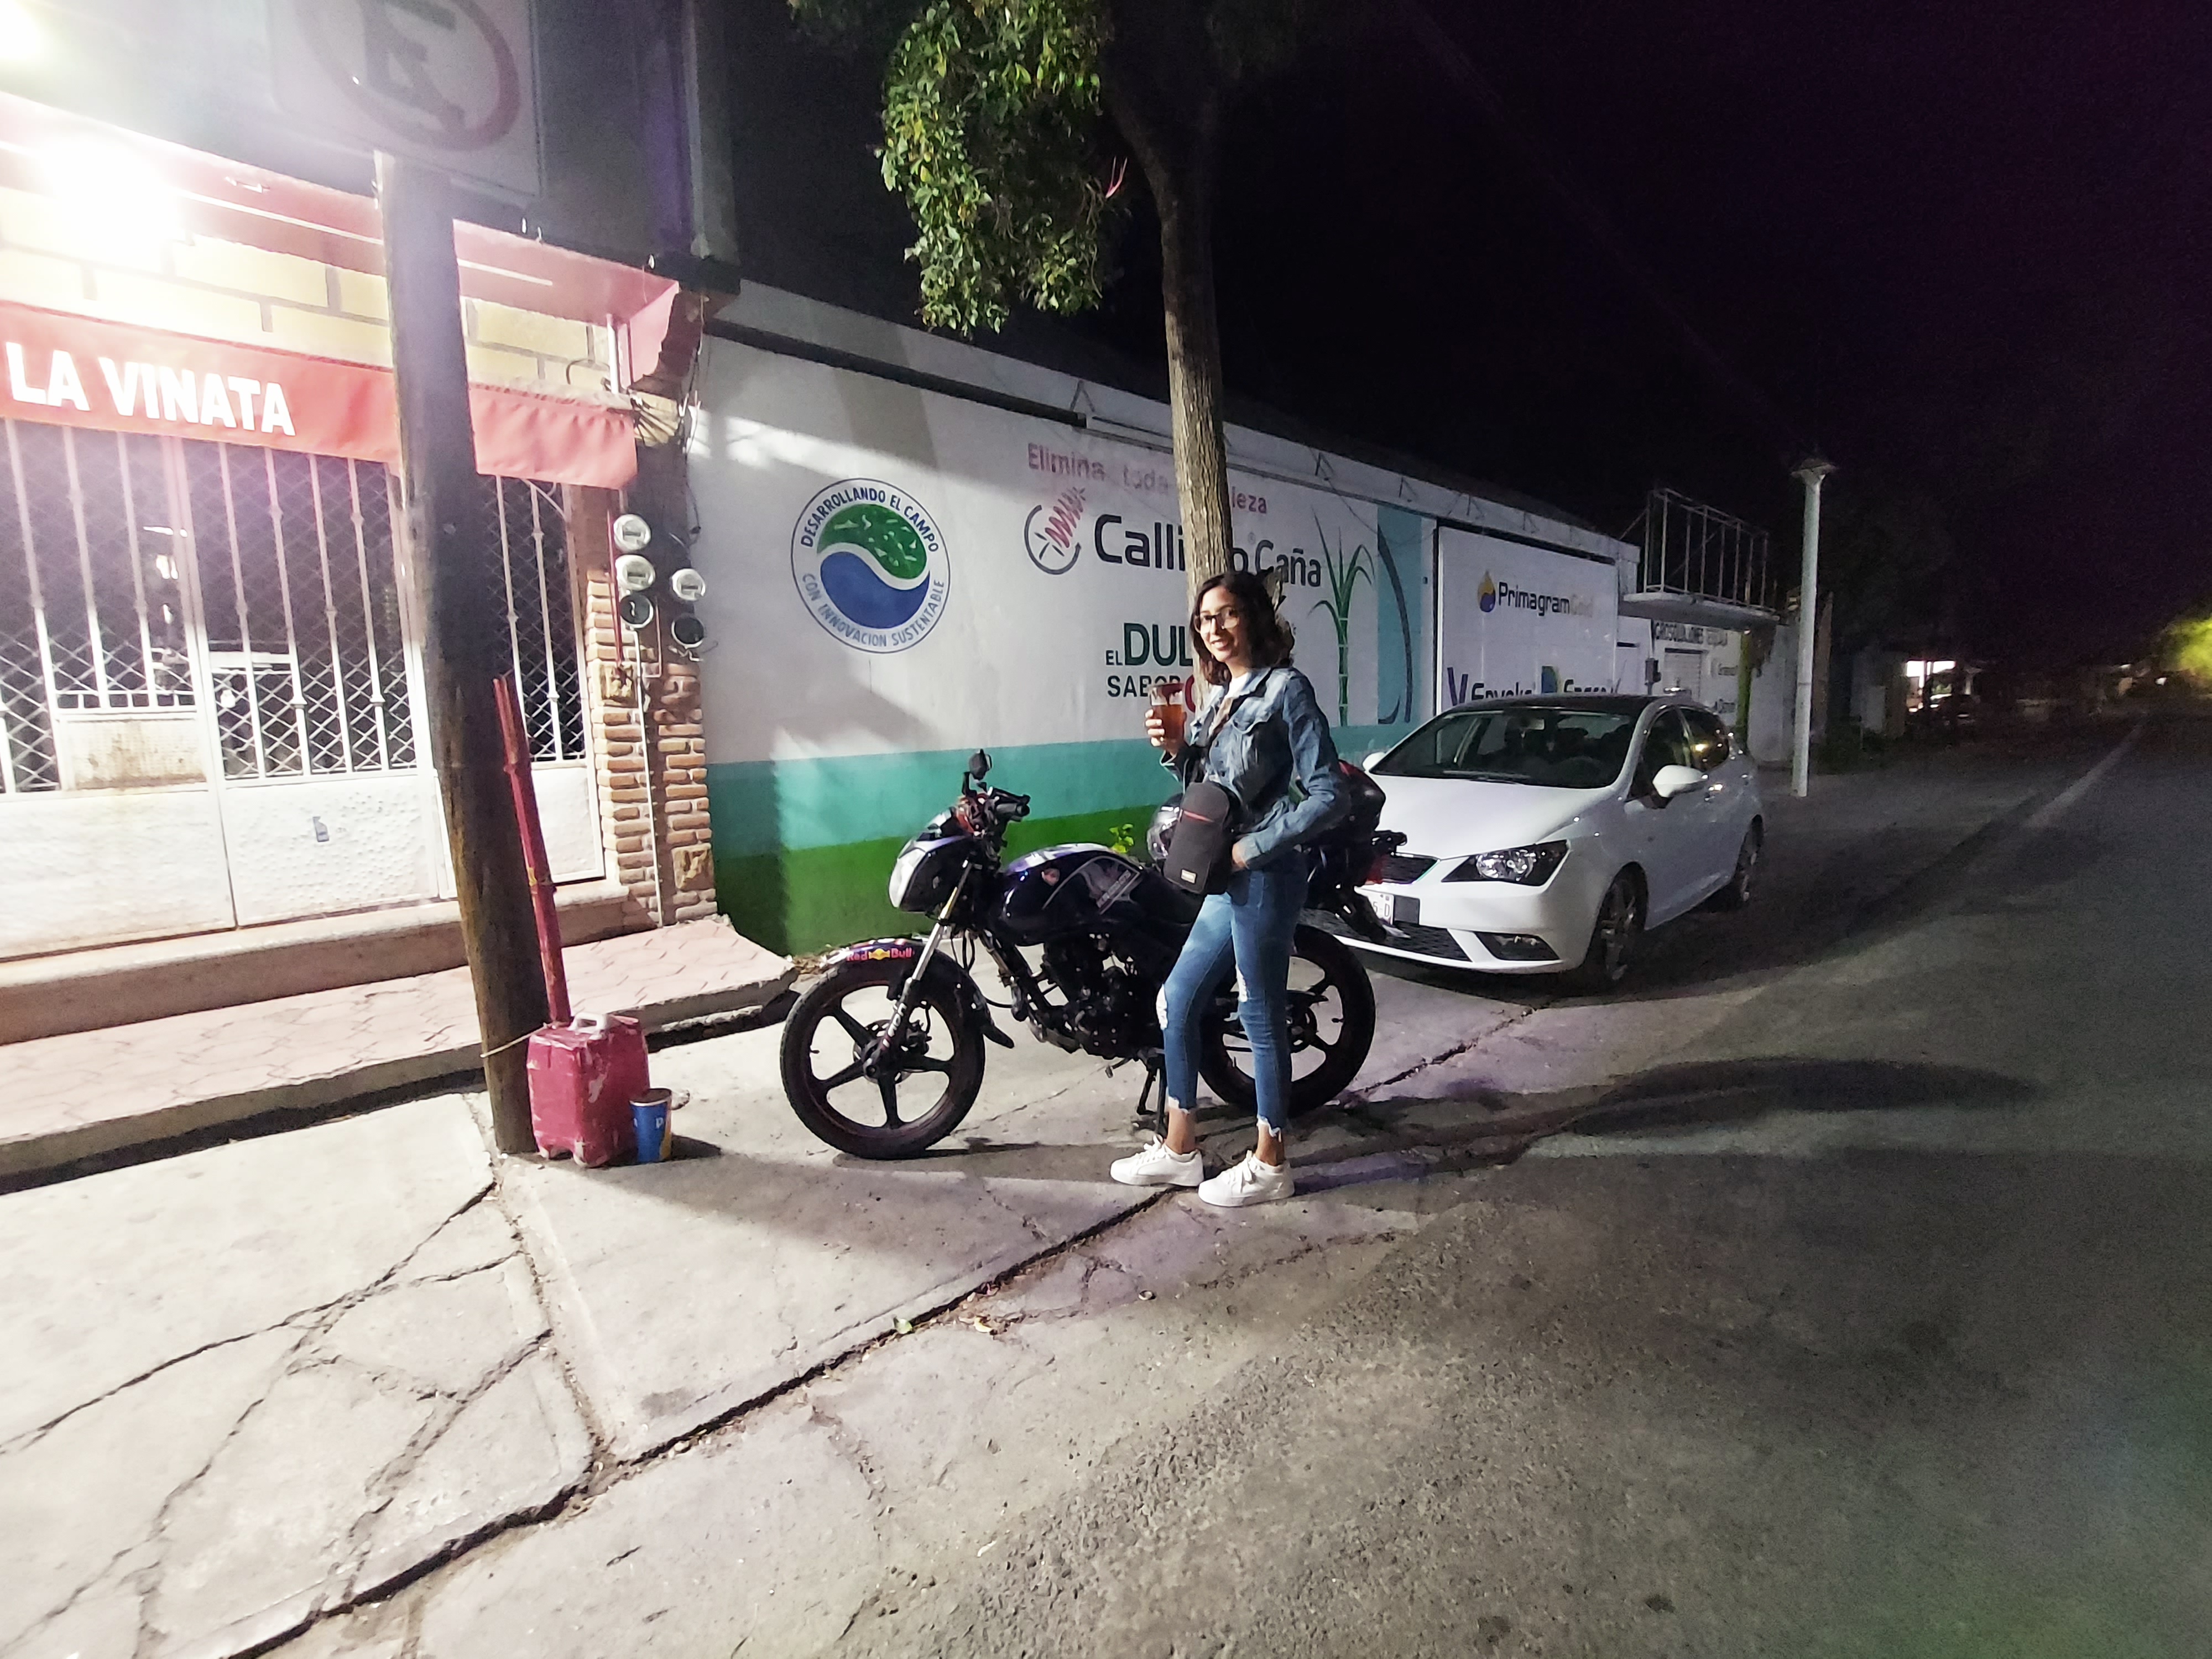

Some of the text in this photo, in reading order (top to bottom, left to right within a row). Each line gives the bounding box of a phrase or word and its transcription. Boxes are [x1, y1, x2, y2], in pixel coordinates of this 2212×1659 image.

[6, 341, 296, 436] LA VINATA
[1027, 442, 1105, 482] Elimina
[1232, 486, 1267, 514] leza
[800, 487, 939, 552] DESARROLLANDO EL CAMPO
[1255, 540, 1321, 587] Caña
[802, 573, 945, 647] CON INNOVACION SUSTENTABLE
[1105, 622, 1193, 667] EL DUL
[846, 947, 912, 961] Red Bull
